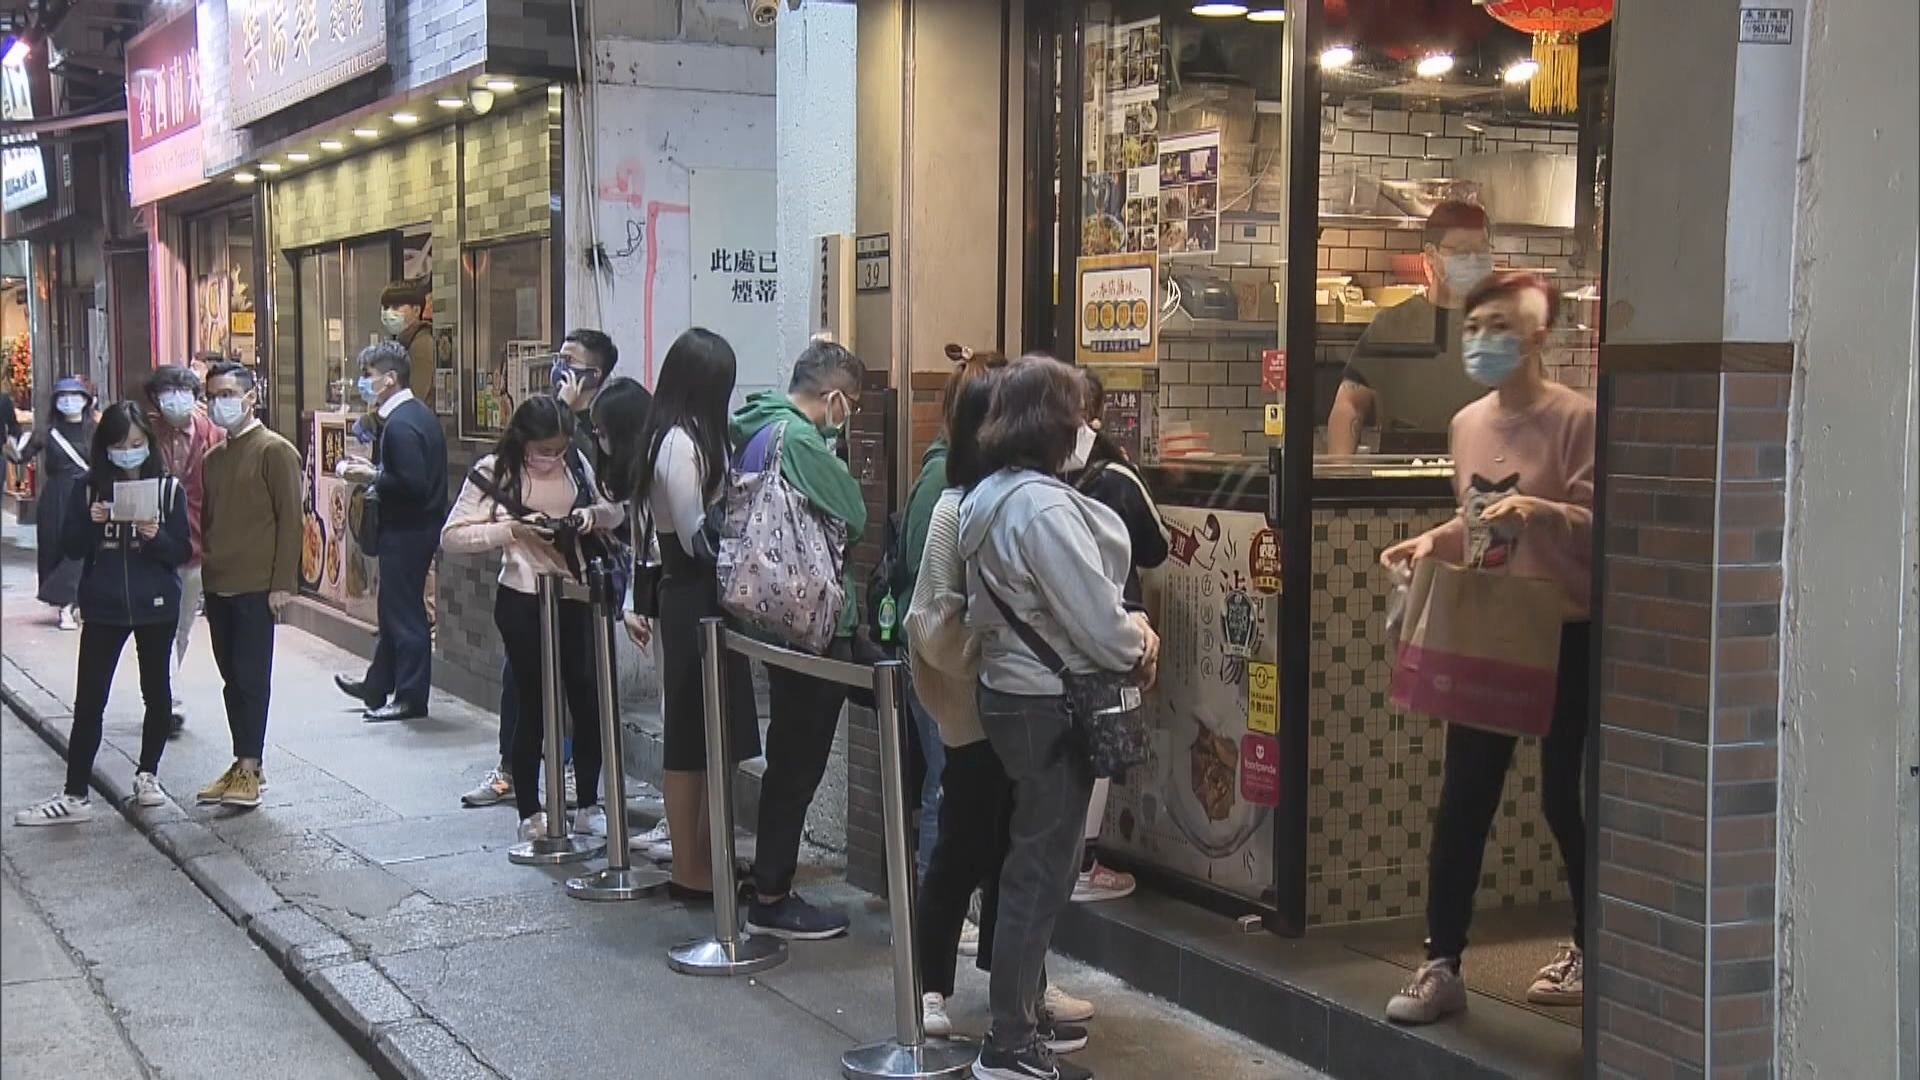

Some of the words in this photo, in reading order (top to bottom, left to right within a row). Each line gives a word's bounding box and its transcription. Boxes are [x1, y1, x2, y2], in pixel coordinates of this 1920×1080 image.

[711, 249, 778, 273] 此處已
[865, 262, 880, 288] 39
[732, 279, 778, 303] 煙蒂
